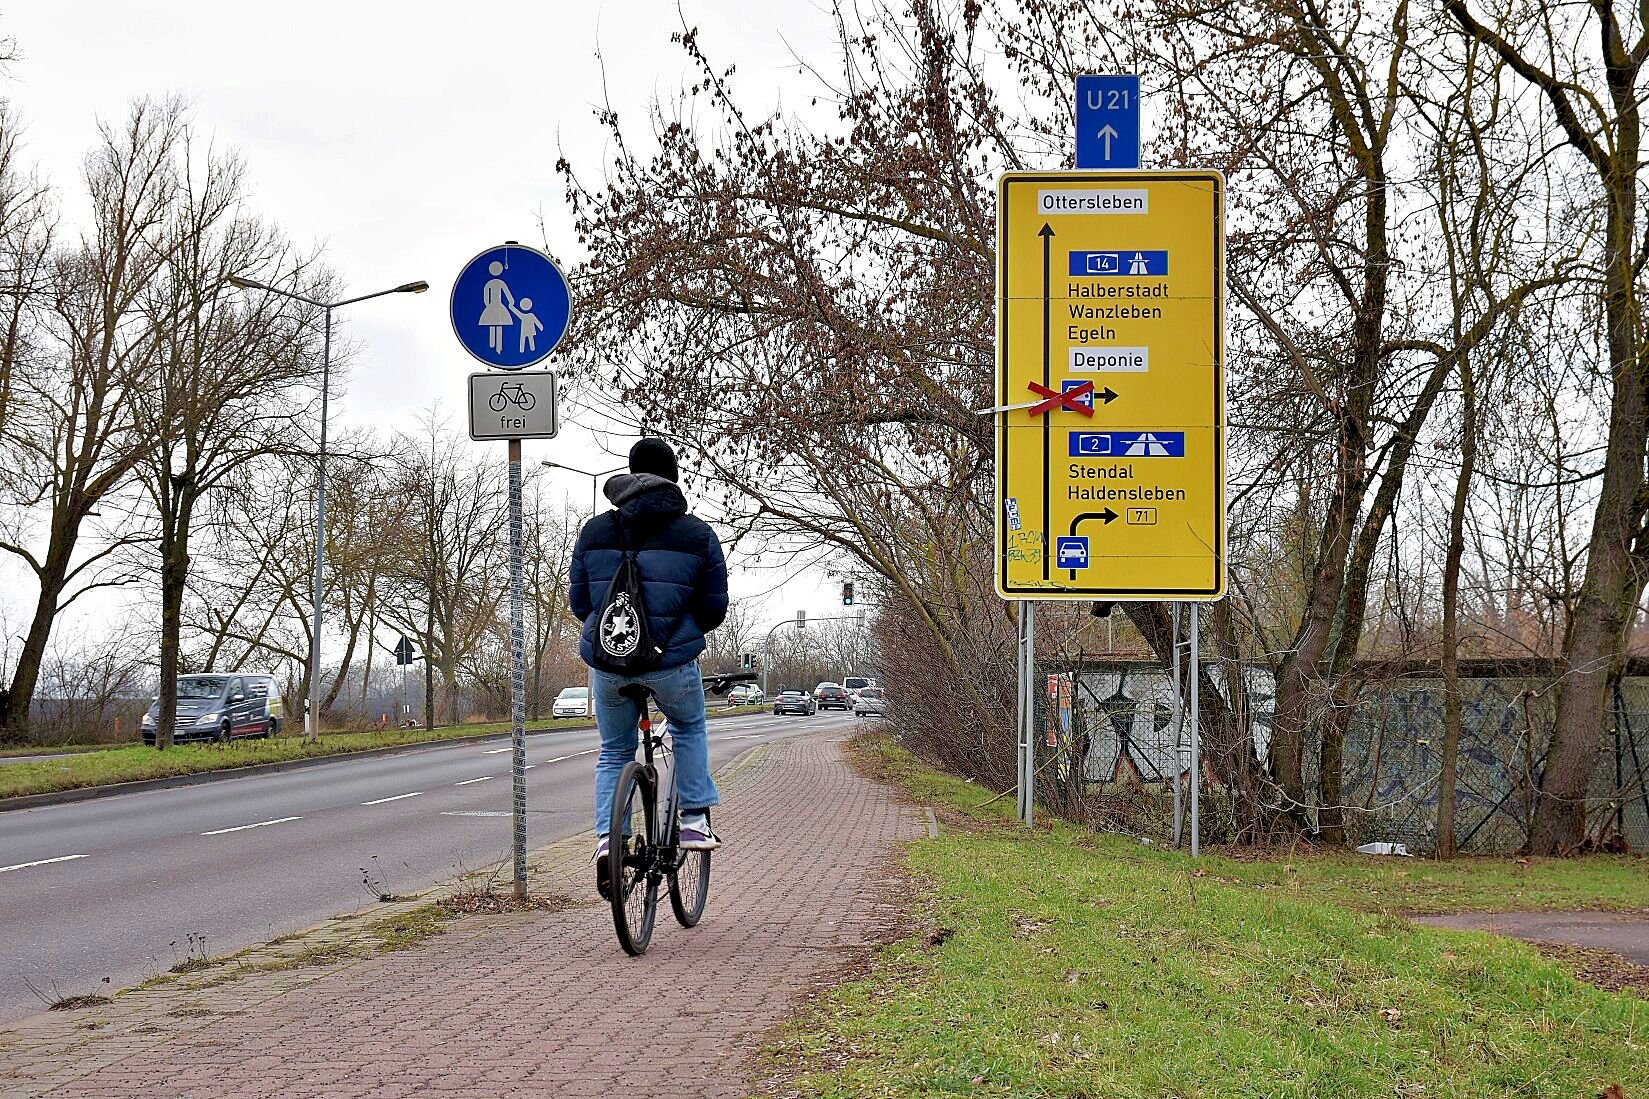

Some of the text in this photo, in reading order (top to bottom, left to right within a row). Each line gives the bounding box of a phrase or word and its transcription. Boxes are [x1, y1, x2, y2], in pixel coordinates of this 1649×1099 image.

[1087, 90, 1129, 110] U 21
[1043, 194, 1143, 210] Ottersleben
[1095, 257, 1110, 270] 14
[1068, 282, 1169, 298] Halberstadt
[1069, 303, 1162, 319] Wanzleben
[1068, 325, 1116, 344] Egeln
[1074, 352, 1143, 370] Deponie
[500, 415, 526, 429] frei
[1091, 438, 1099, 450] 2
[1068, 463, 1134, 479] Stendal
[1068, 485, 1186, 501] Haldensleben
[1135, 510, 1149, 522] 71
